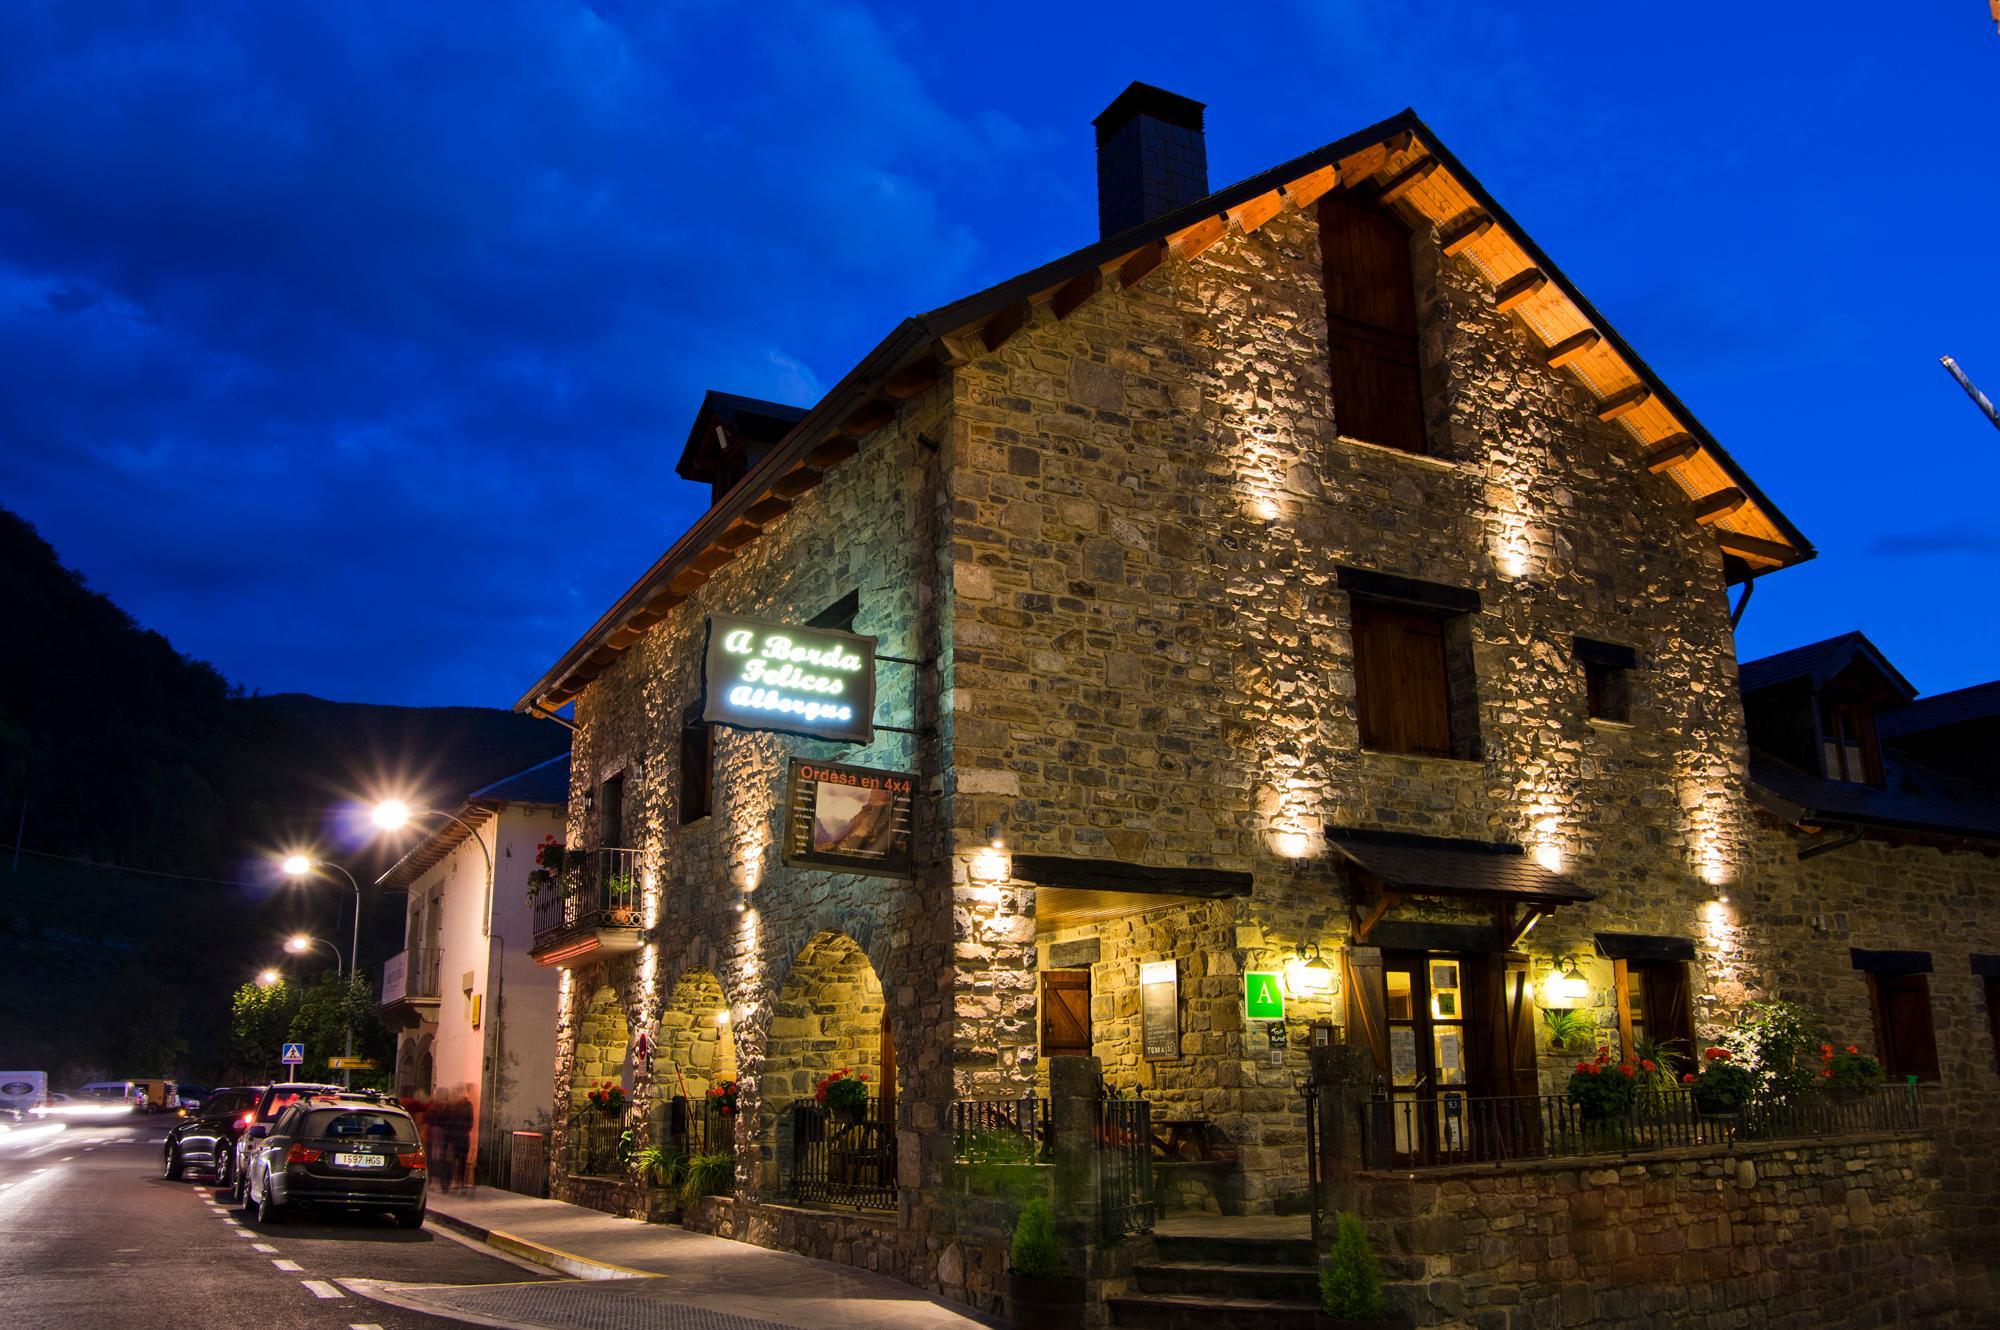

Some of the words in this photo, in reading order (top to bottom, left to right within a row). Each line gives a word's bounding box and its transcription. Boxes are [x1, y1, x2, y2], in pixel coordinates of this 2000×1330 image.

[725, 630, 754, 654] A
[761, 635, 862, 671] Borda
[741, 658, 844, 694] Felices
[729, 685, 852, 721] Albergue
[801, 765, 857, 786] Ordesa
[861, 777, 879, 789] en
[884, 778, 911, 793] 4x4
[1256, 980, 1273, 1004] A
[343, 1155, 363, 1164] 1597
[365, 1155, 381, 1165] HGS
